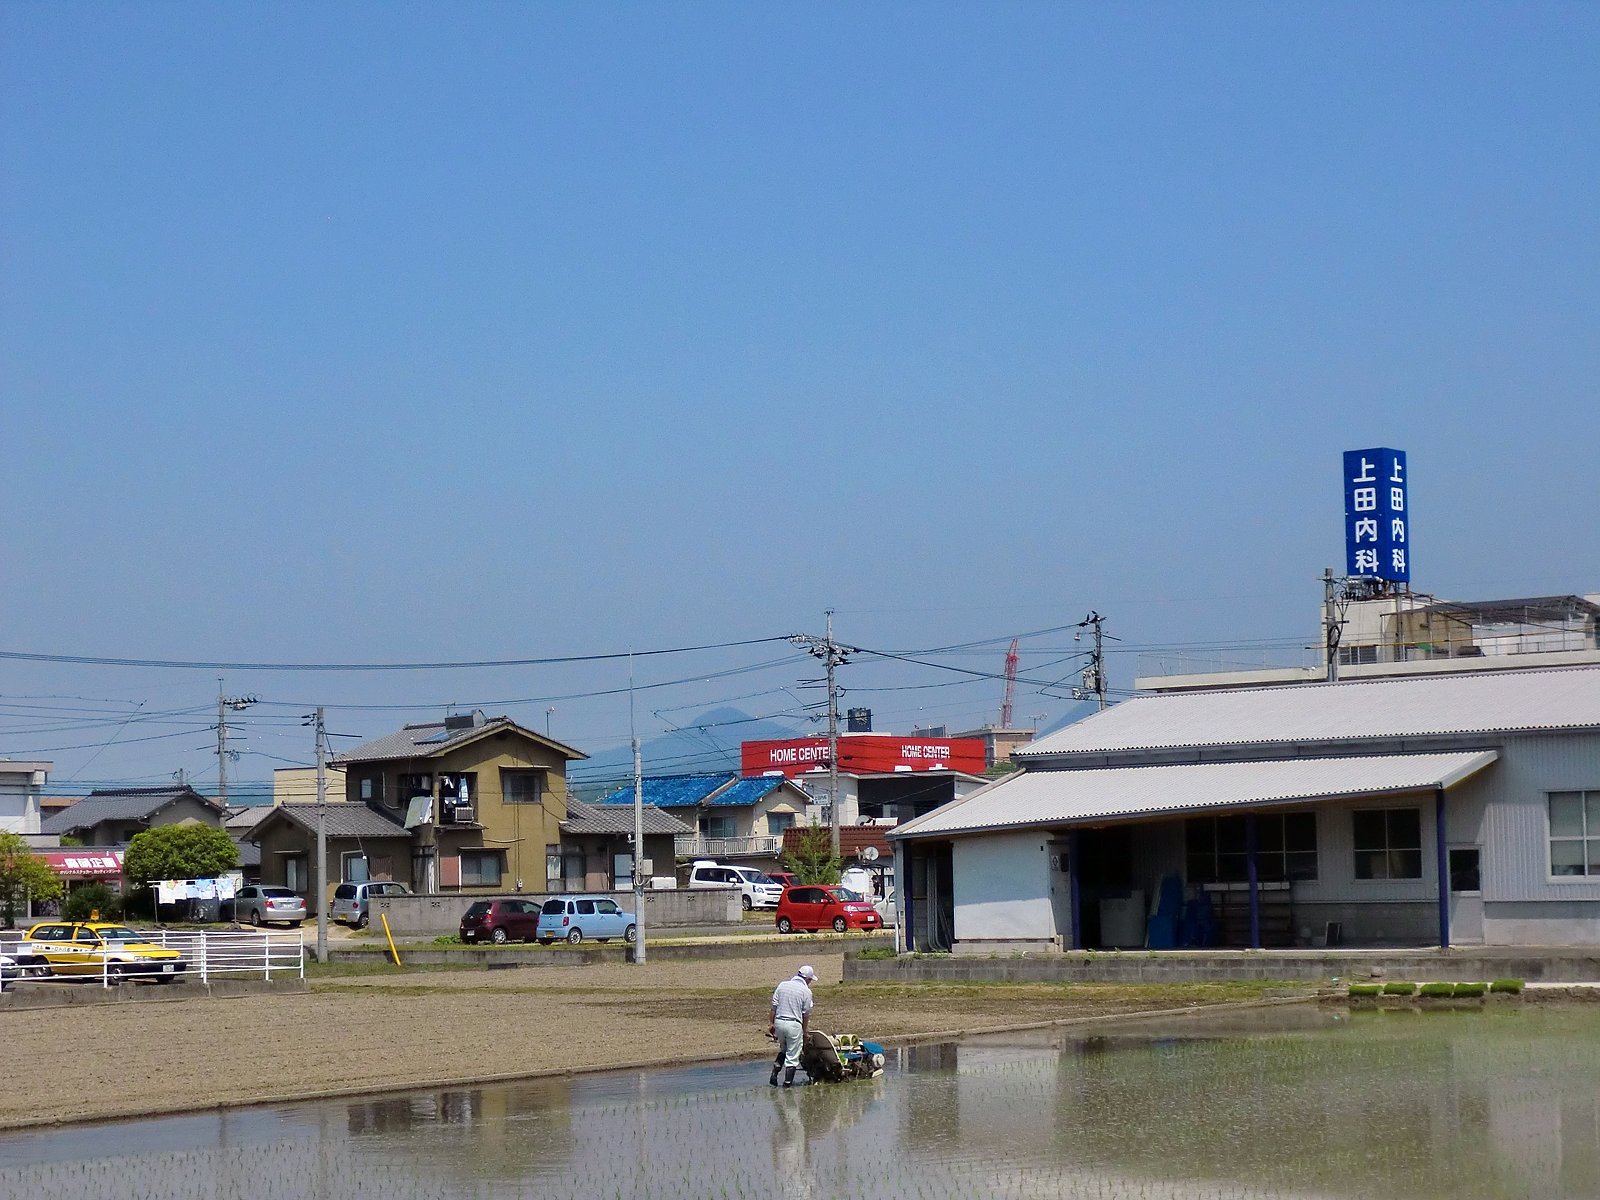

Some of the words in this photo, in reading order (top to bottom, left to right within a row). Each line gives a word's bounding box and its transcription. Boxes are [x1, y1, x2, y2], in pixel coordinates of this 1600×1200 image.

[1353, 457, 1379, 574] 上田内科
[1390, 457, 1406, 573] 上田内科
[770, 748, 797, 762] HOME
[798, 746, 831, 761] CENTE
[901, 745, 922, 758] HOME
[923, 745, 950, 759] CENTER
